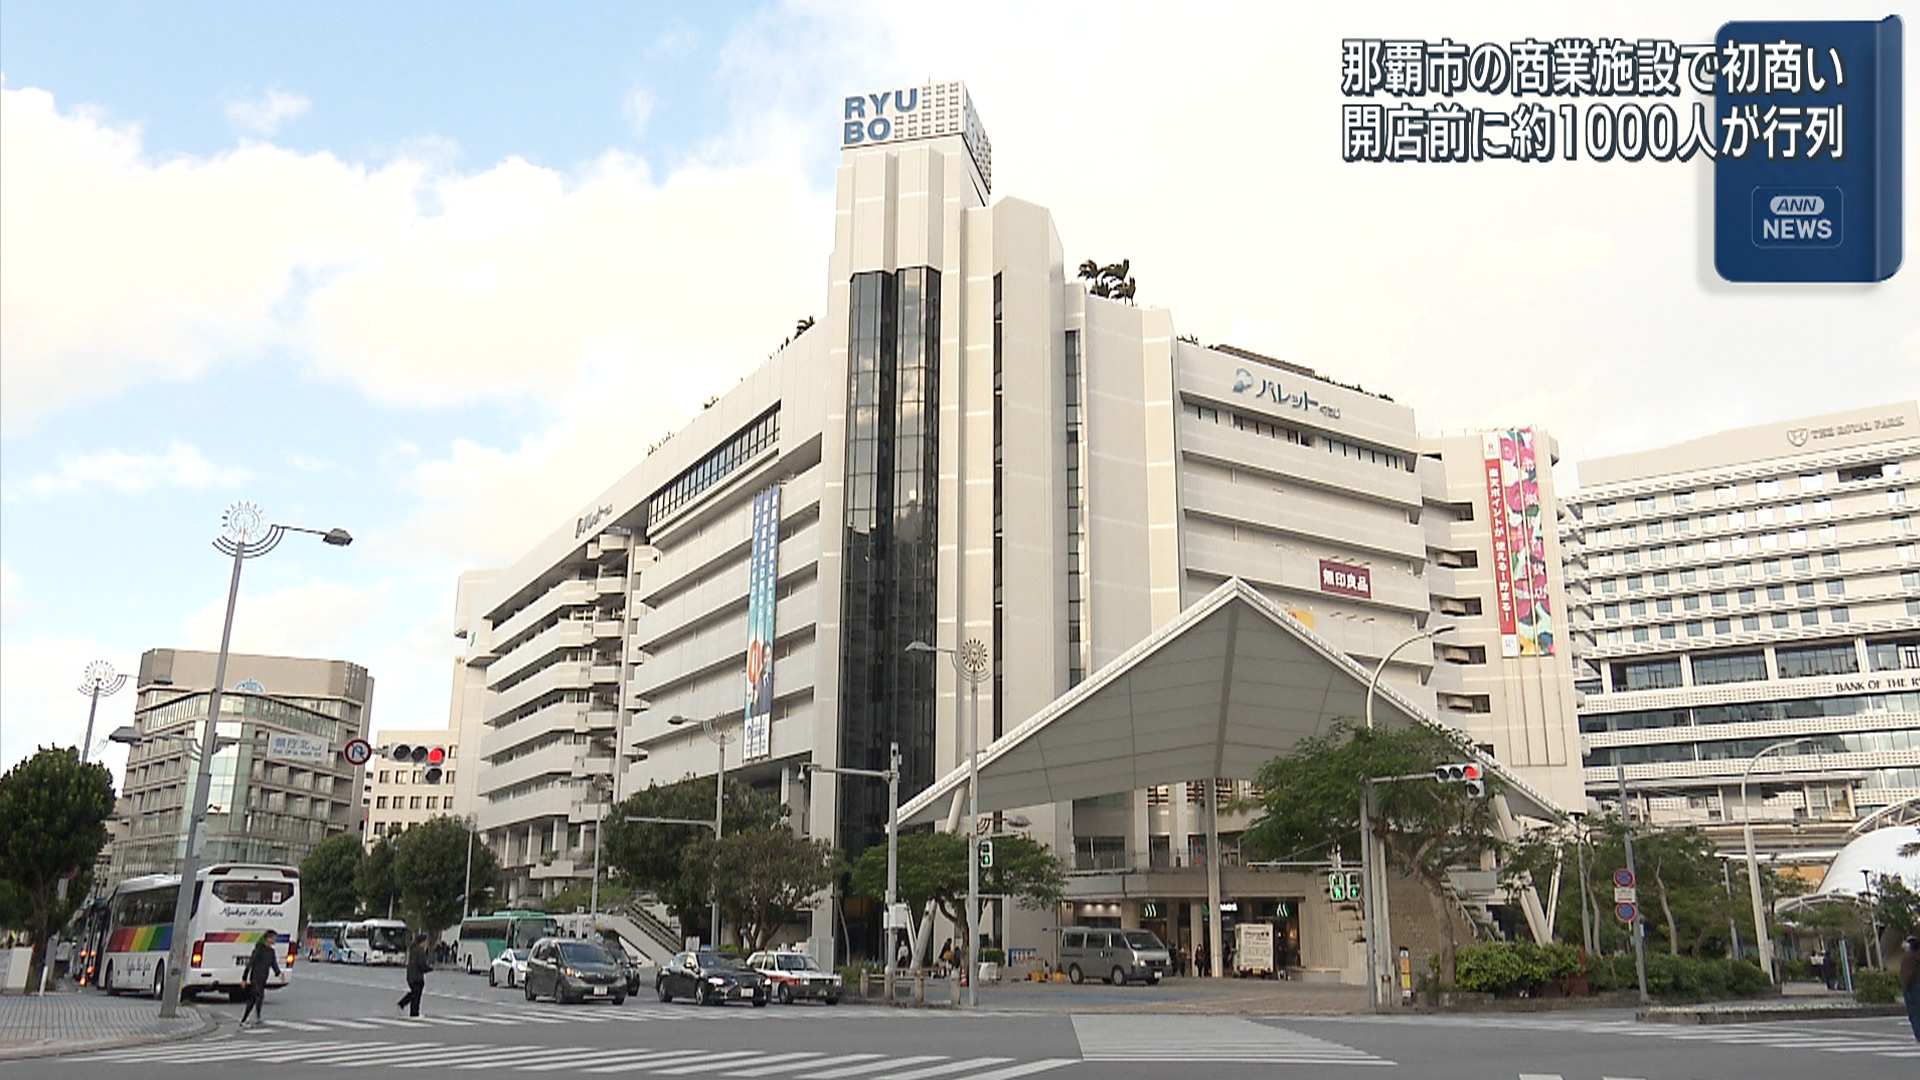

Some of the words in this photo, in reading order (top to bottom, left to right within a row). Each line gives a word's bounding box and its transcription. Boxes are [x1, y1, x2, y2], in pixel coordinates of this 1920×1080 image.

[845, 88, 917, 118] RYU
[844, 118, 890, 144] BO
[1810, 426, 1835, 440] THE
[1836, 421, 1873, 436] ROYAL
[1874, 415, 1906, 430] PARK
[1322, 567, 1369, 593] 無印良品
[1836, 682, 1866, 693] BANK
[1867, 679, 1882, 690] OF
[1887, 678, 1908, 689] THE
